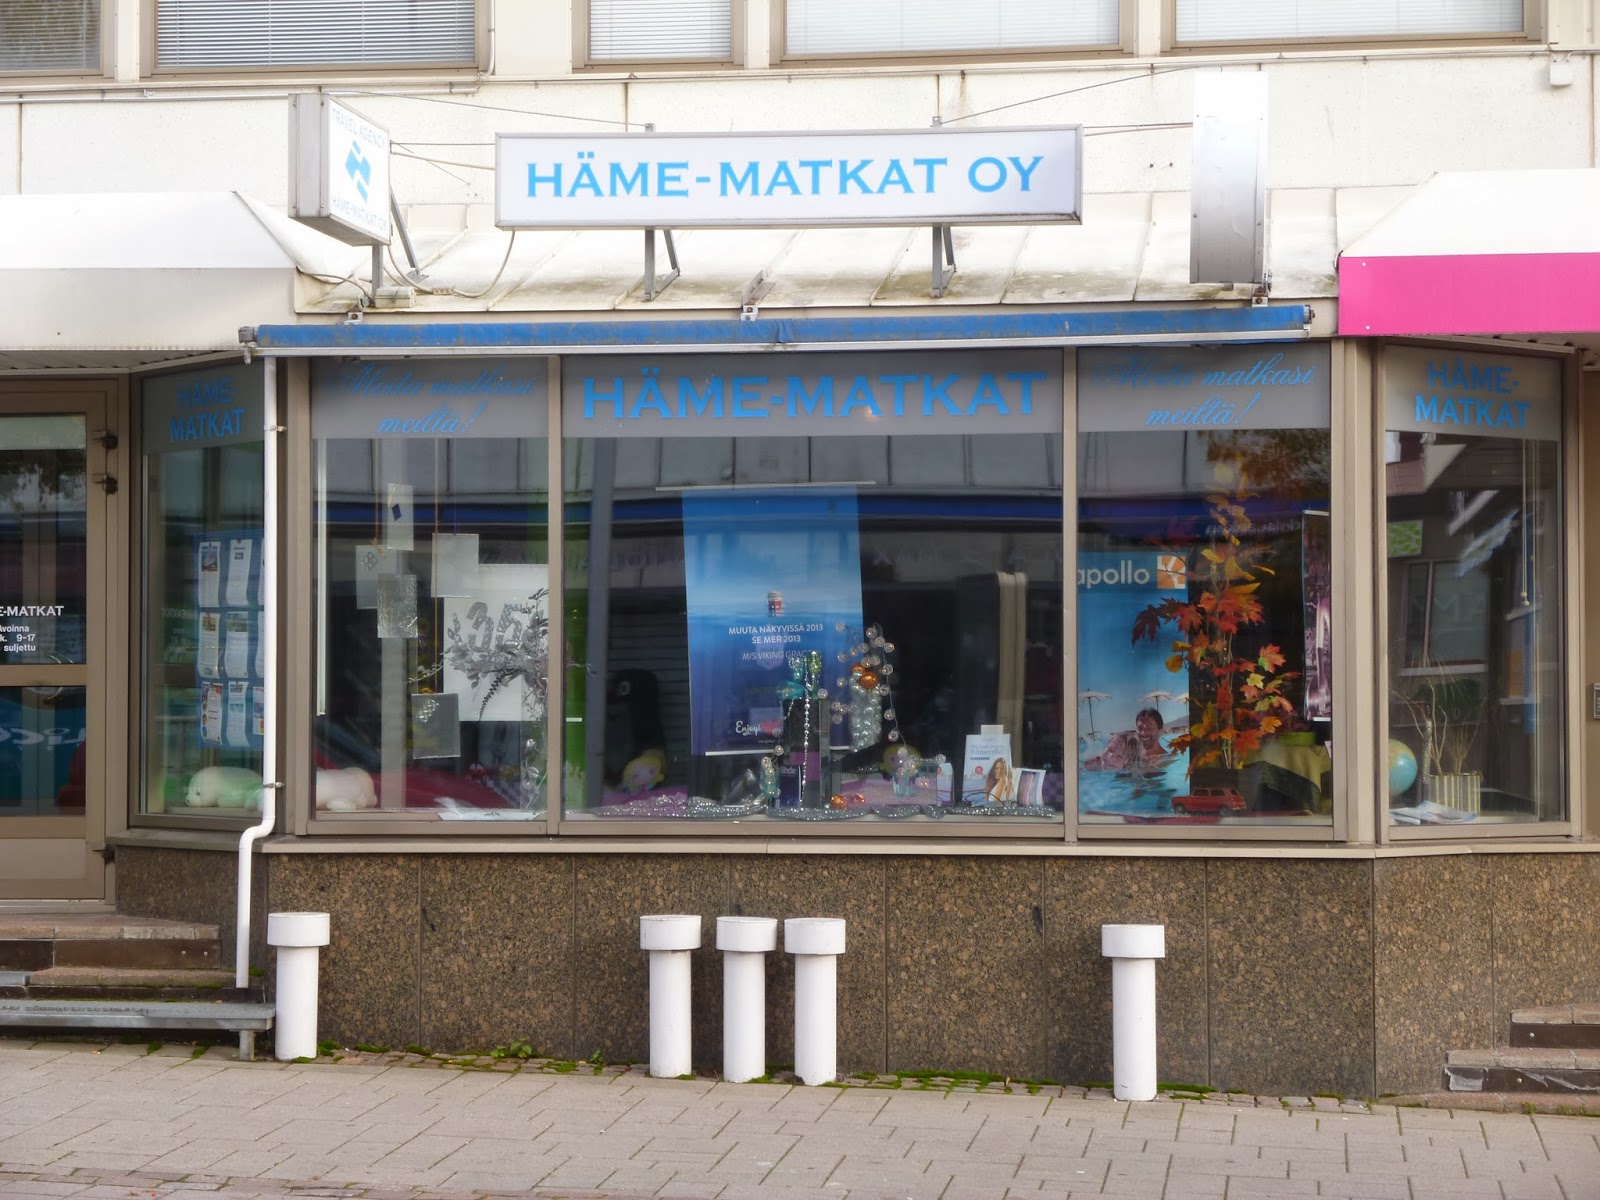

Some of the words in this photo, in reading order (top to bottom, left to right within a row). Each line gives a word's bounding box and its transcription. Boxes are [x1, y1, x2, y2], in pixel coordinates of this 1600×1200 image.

[527, 151, 947, 198] HÄME-MATKAT
[968, 155, 1044, 191] OY
[1201, 351, 1318, 386] matkasi
[1427, 356, 1520, 394] HÄME-
[176, 377, 237, 407] HÄME-
[583, 367, 1047, 419] HÄME-MATKAT
[169, 408, 245, 442] MATKAT
[1143, 391, 1263, 427] meiltä!
[1415, 394, 1532, 430] MATKAT
[1077, 560, 1150, 589] apollo
[16, 633, 36, 643] 9-17
[728, 627, 758, 635] MUUTA
[759, 624, 805, 634] NÄKYVISSÄ
[806, 624, 824, 632] 2013
[752, 636, 762, 644] SE
[763, 636, 782, 644] MER
[783, 635, 801, 643] 2013
[3, 643, 36, 653] suljettu
[757, 652, 784, 660] VIKING
